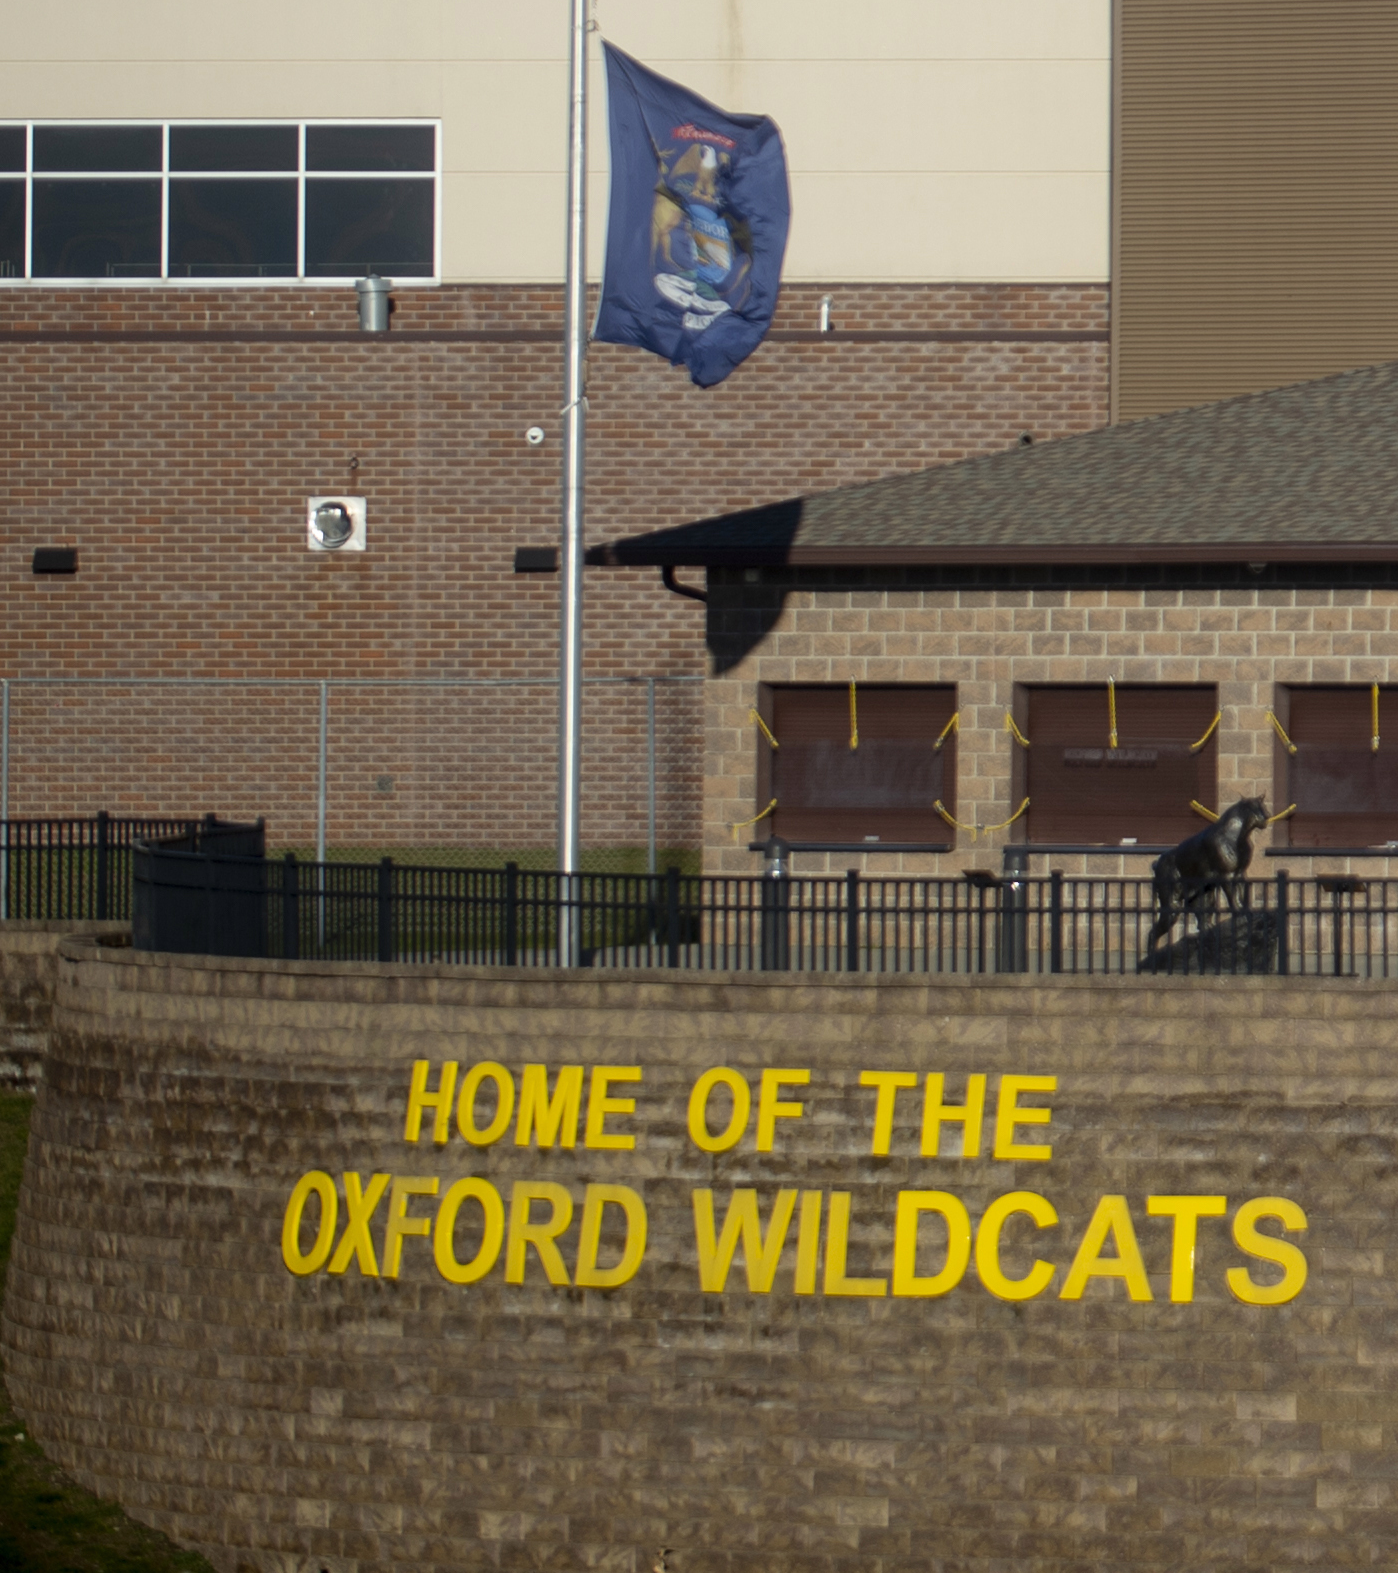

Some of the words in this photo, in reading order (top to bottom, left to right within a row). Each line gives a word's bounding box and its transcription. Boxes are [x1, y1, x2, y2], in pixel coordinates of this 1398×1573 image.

[405, 1060, 642, 1150] HOME
[687, 1067, 811, 1154] OF
[859, 1070, 1058, 1162] THE
[281, 1170, 648, 1289] OXFORD
[693, 1189, 1308, 1306] WILDCATS
